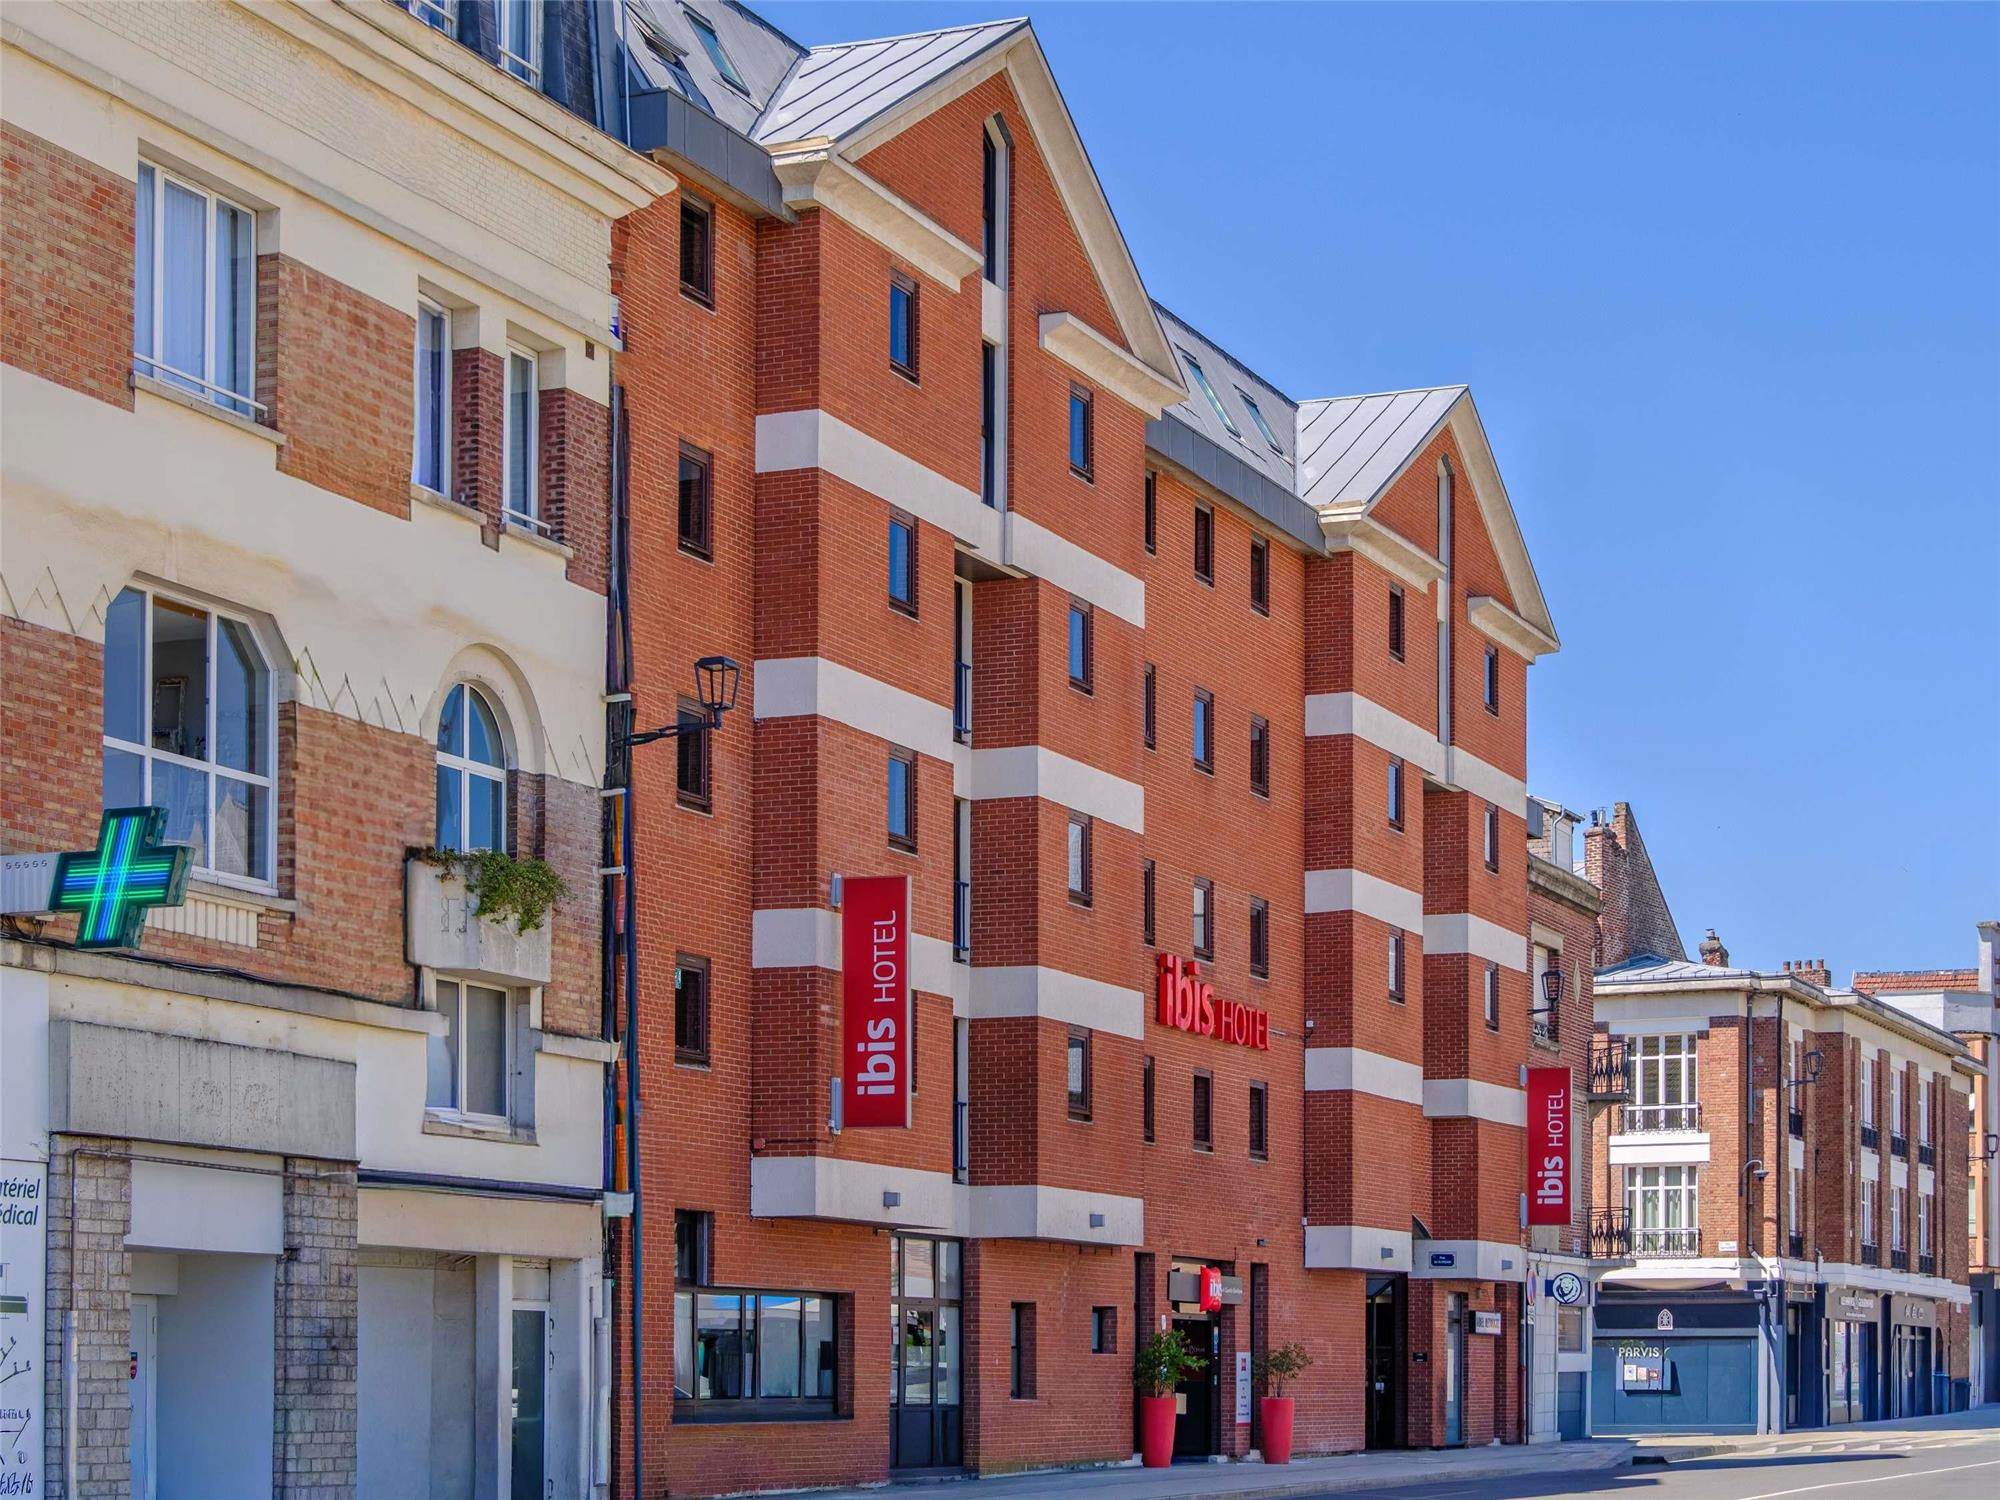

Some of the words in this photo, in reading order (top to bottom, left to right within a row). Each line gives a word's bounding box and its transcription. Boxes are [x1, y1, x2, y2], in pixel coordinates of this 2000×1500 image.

[873, 910, 897, 1003] HOTEL
[1160, 953, 1215, 1037] ibis
[1219, 999, 1271, 1051] HOTEL
[857, 1017, 896, 1095] ibis
[1548, 1088, 1564, 1147] HOTEL
[0, 1177, 41, 1199] tériel
[1537, 1155, 1564, 1205] ibis
[1618, 1347, 1660, 1358] PARVIS
